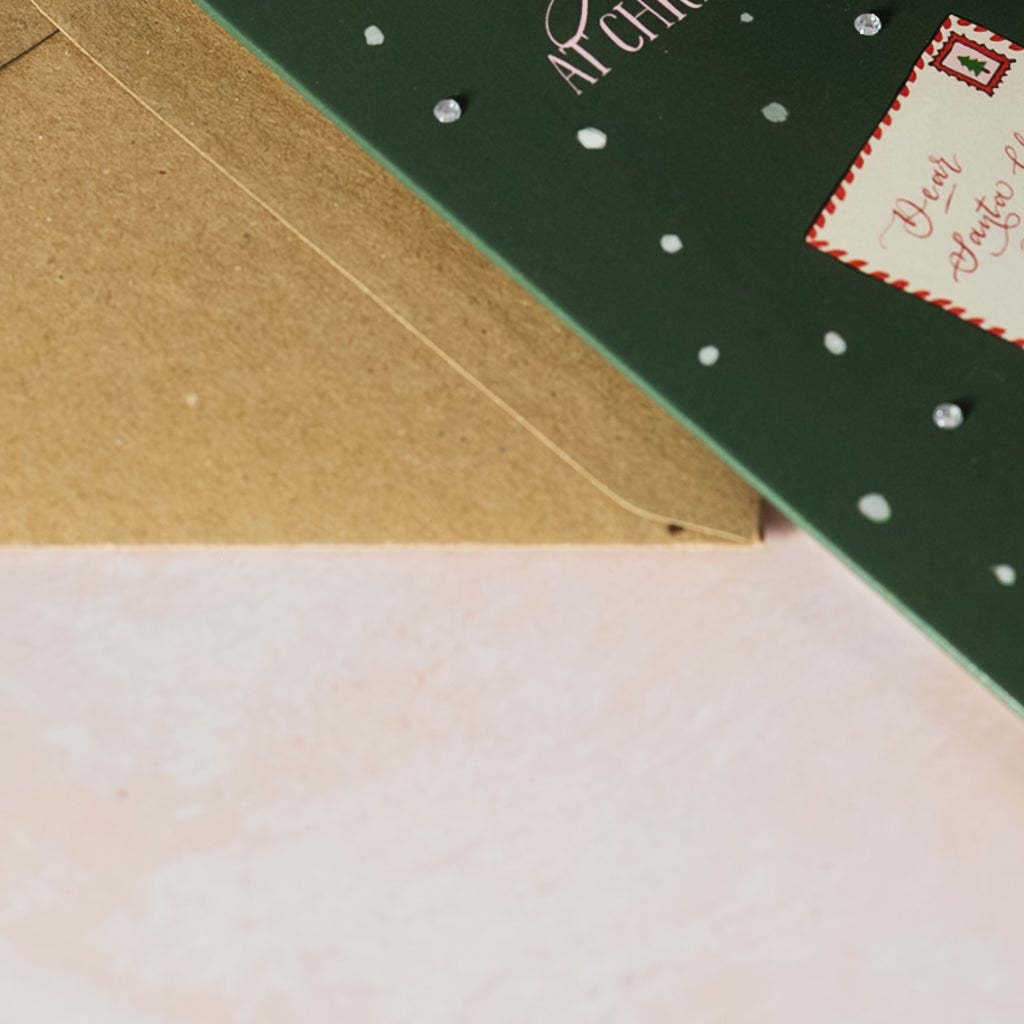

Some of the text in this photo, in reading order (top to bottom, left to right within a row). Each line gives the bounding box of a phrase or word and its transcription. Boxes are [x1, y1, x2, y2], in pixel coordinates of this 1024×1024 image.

[547, 32, 612, 95] AT
[878, 153, 963, 250] Dear
[949, 180, 1022, 283] Santa
